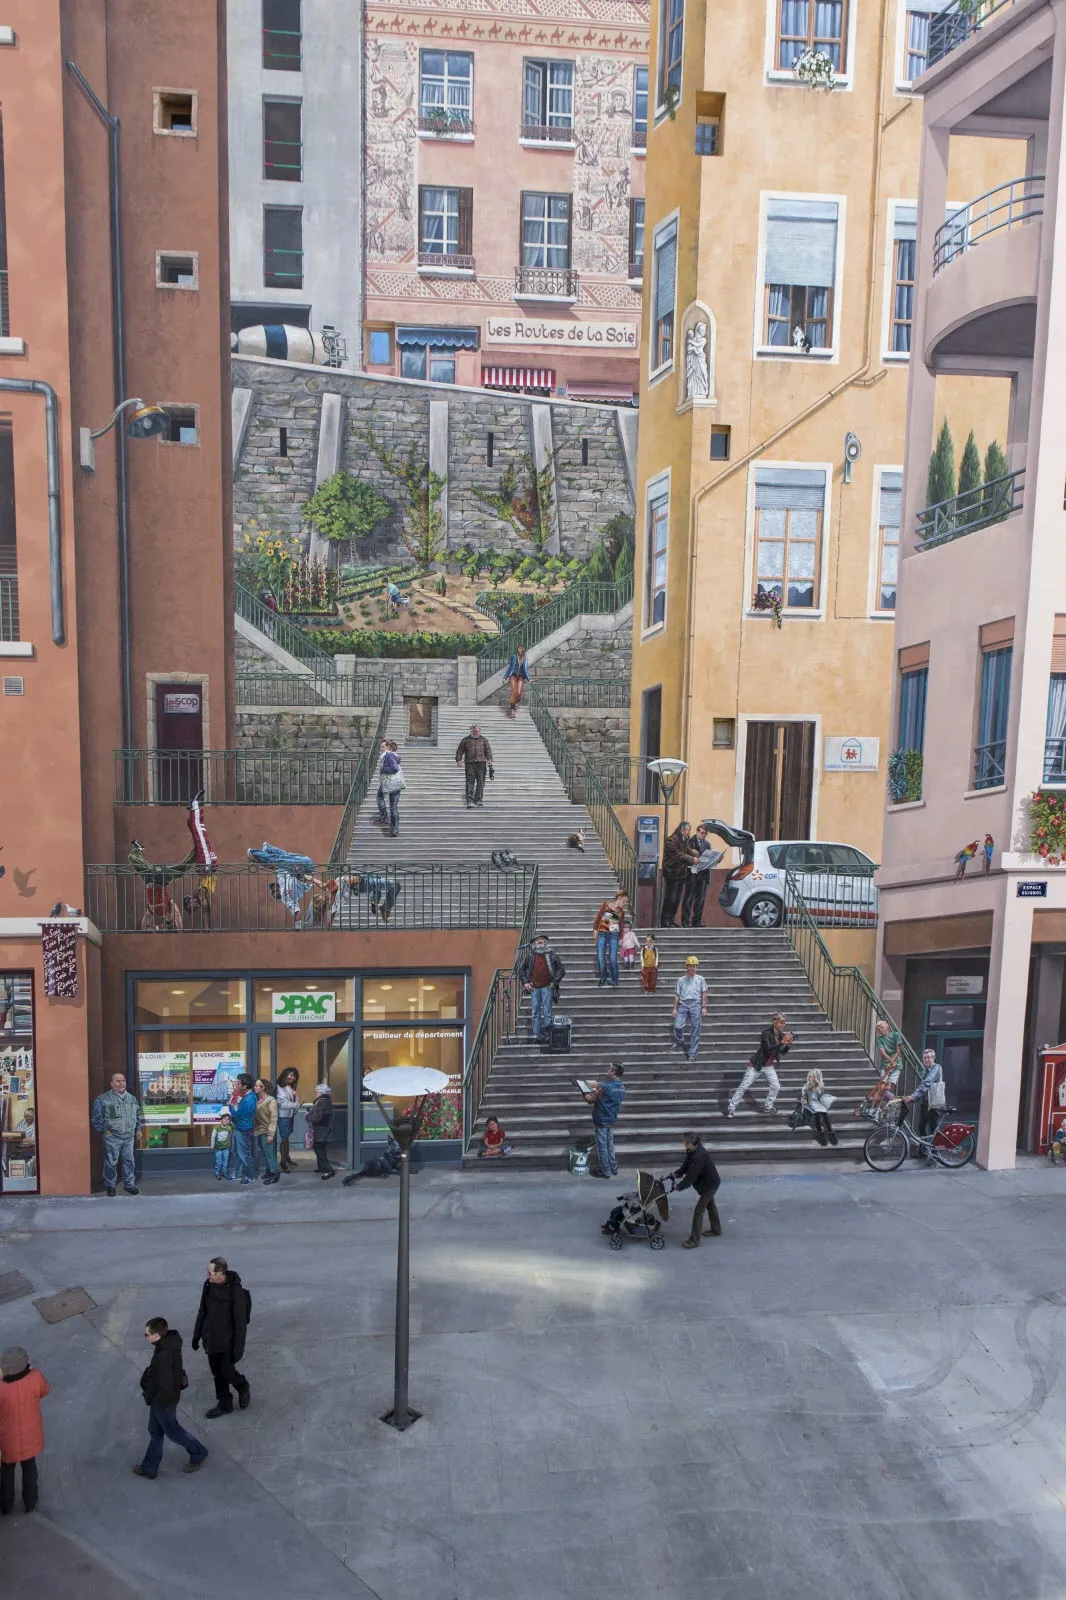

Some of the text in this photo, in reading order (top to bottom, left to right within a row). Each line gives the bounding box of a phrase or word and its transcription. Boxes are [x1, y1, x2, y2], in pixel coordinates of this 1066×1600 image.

[488, 321, 511, 337] Les
[515, 323, 564, 340] Routes
[568, 326, 583, 341] de
[606, 326, 635, 344] Soie
[373, 1031, 401, 1039] bailleur
[403, 1031, 413, 1039] du
[415, 1030, 463, 1039] département
